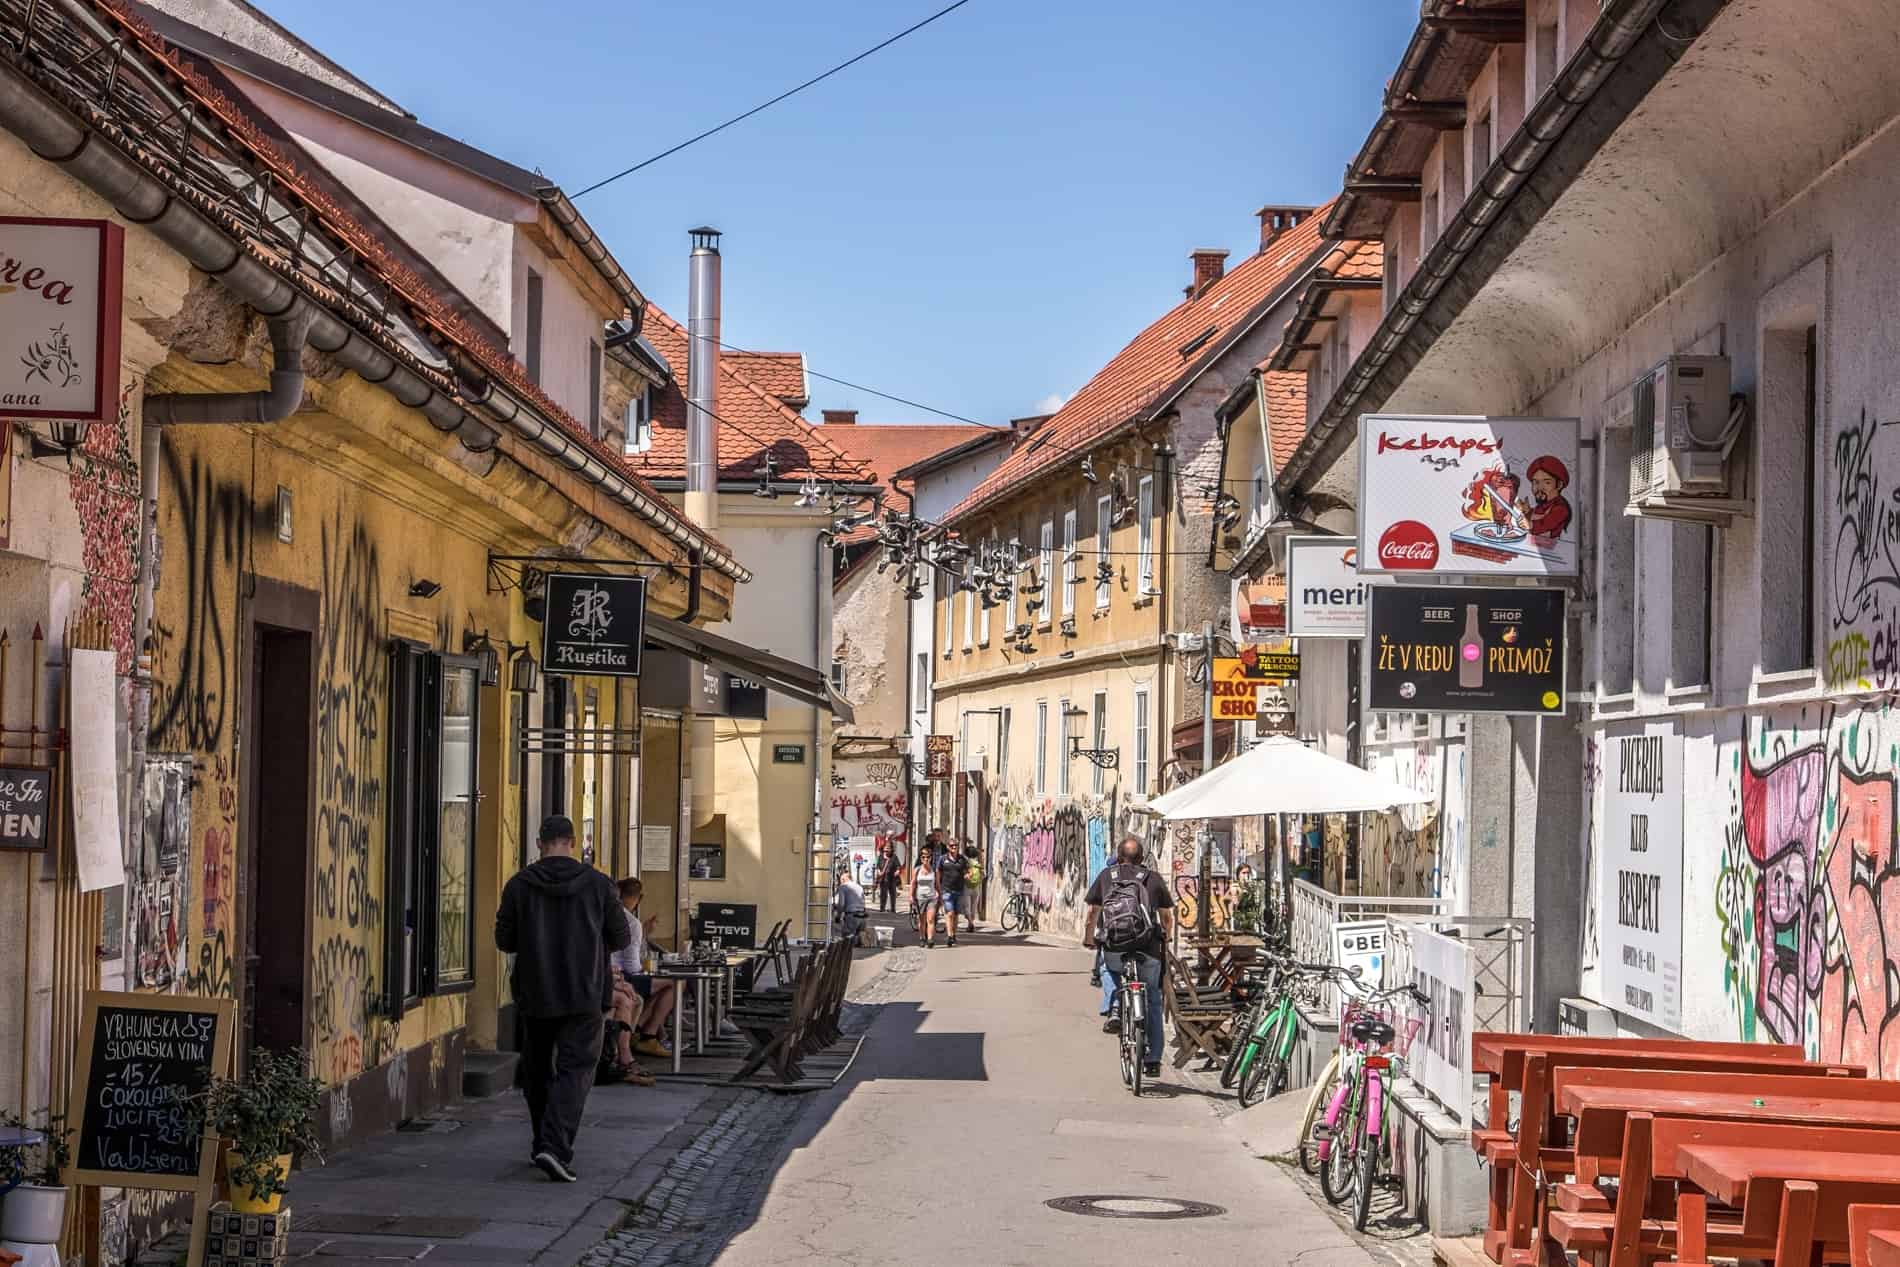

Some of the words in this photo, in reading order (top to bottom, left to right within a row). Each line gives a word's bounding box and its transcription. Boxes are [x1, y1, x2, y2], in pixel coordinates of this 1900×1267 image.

[0, 252, 74, 306] rea
[0, 392, 41, 406] ana
[1303, 582, 1369, 605] meri
[1424, 610, 1450, 619] BEER
[1492, 612, 1522, 620] SHOP
[556, 646, 627, 666] Rustika
[1259, 656, 1298, 664] TATTOO
[1378, 634, 1396, 671] ŽE
[1400, 644, 1412, 670] V
[1415, 645, 1454, 672] REDU
[1489, 638, 1552, 674] PRIMOŽ
[1220, 700, 1256, 716] SHO
[1619, 735, 1664, 802] PICERIJA
[0, 814, 41, 839] EN
[1630, 813, 1649, 853] KLUB
[1618, 869, 1661, 933] RESPECT
[1356, 935, 1386, 950] BE
[104, 1013, 180, 1040] VRHUNSKA
[104, 1040, 174, 1060] SLOVENSKA
[178, 1042, 205, 1062] VINA
[104, 1108, 185, 1128] LUCIFER
